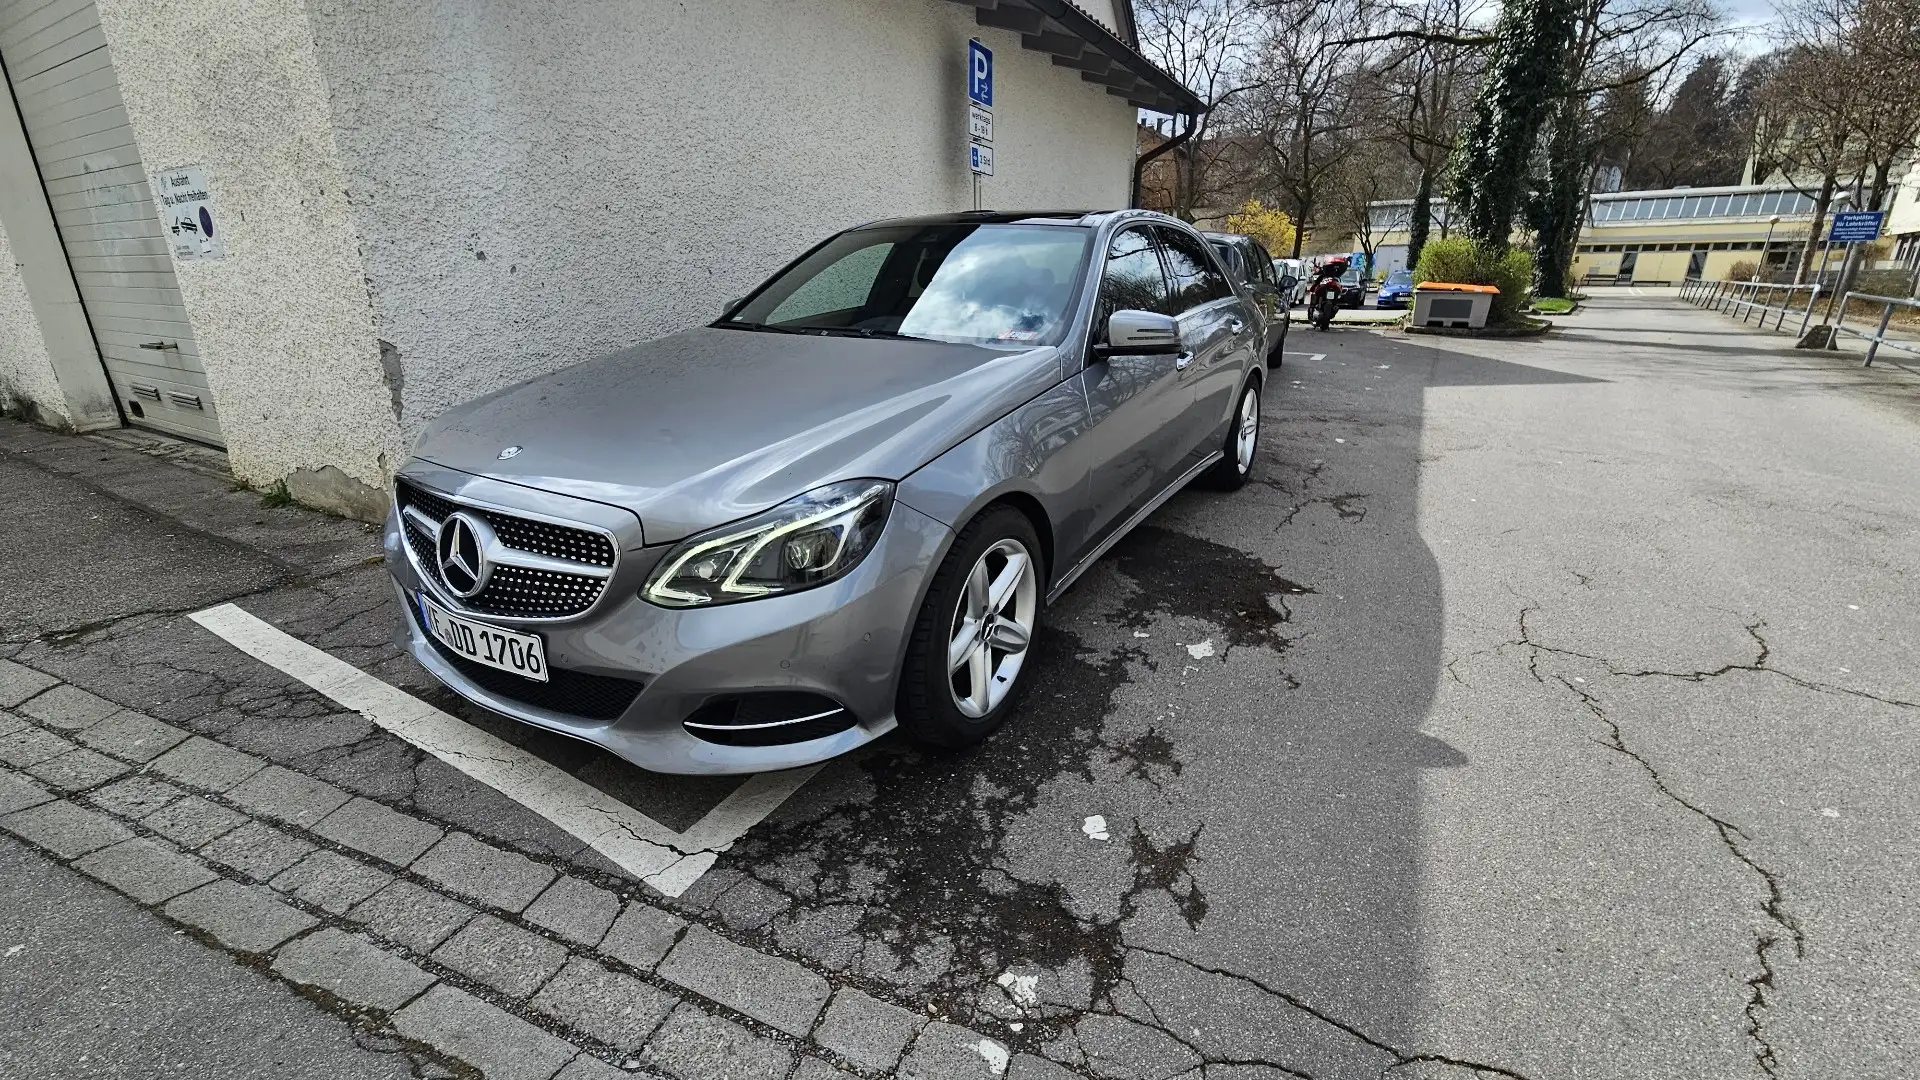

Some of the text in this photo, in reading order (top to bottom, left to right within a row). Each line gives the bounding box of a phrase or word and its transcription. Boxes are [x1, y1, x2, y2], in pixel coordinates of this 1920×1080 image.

[974, 49, 988, 94] P
[170, 172, 190, 187] Ausfahrt
[160, 194, 171, 207] Tag
[174, 191, 189, 205] Nacht
[449, 618, 477, 656] DD
[479, 630, 541, 674] 1706
